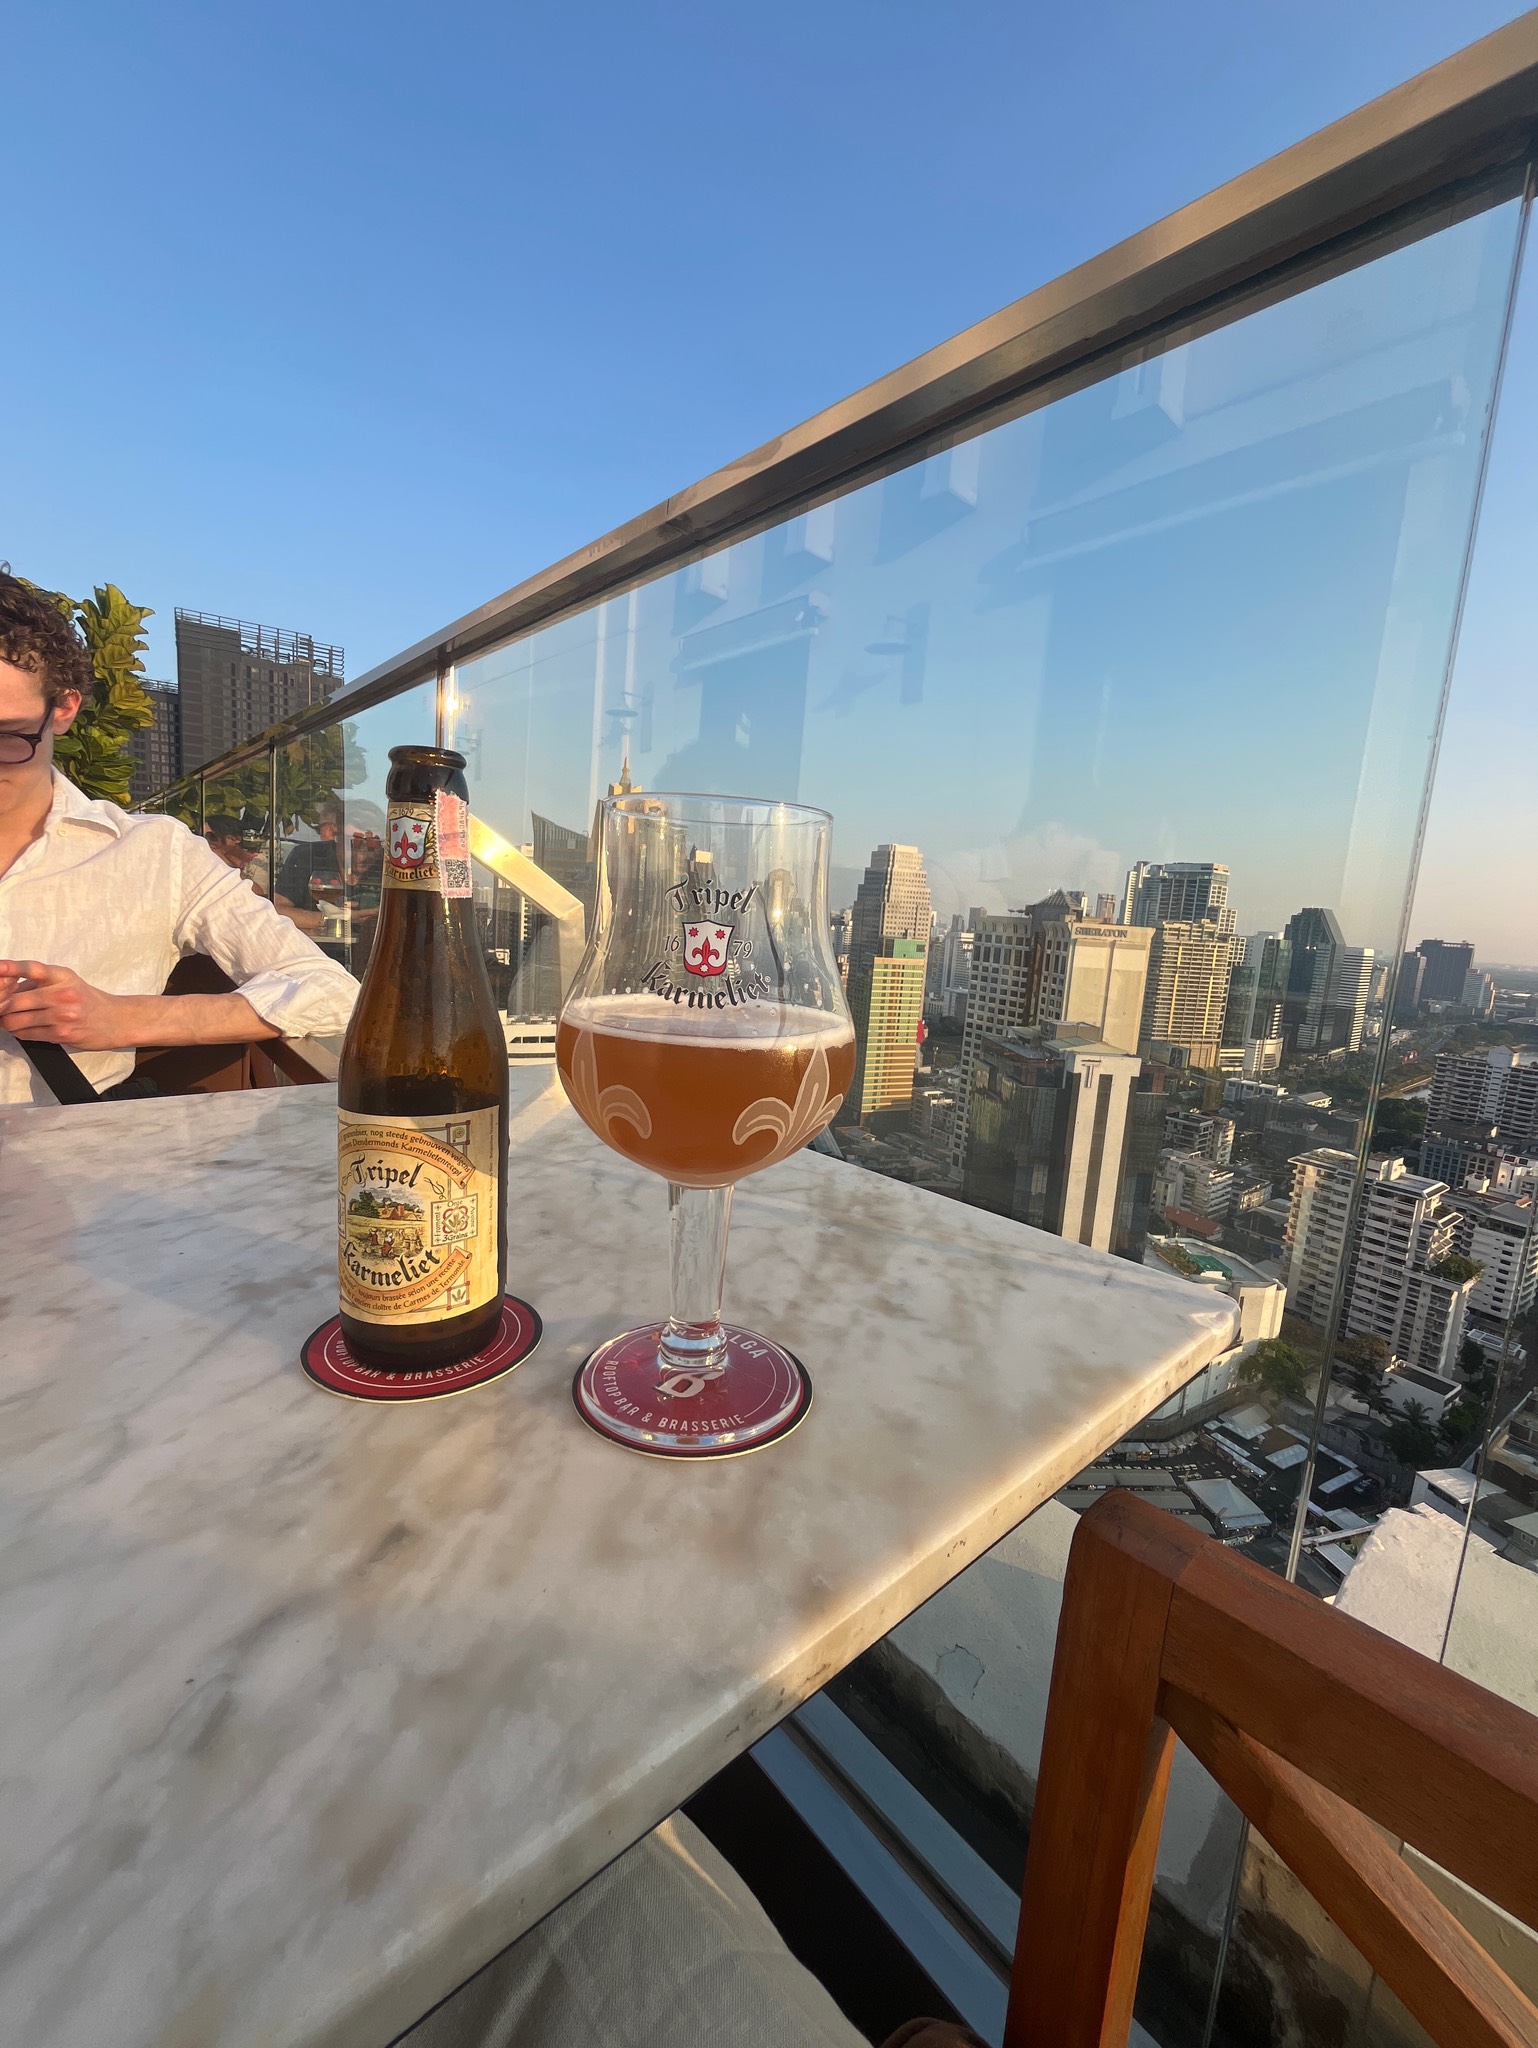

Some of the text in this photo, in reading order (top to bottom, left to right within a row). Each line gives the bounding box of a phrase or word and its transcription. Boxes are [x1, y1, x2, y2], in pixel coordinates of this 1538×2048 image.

[665, 873, 759, 914] Tripel
[664, 935, 753, 958] 16 79
[1075, 926, 1128, 938] SHERATON
[641, 959, 770, 1010] Karmeliet
[350, 1152, 425, 1189] Tripel
[352, 1138, 398, 1148] Dendermonds
[401, 1142, 463, 1177] Karmelietenrecept
[370, 1130, 384, 1138] nog
[385, 1130, 409, 1140] steeds
[410, 1135, 451, 1156] gebrouwen
[450, 1152, 471, 1173] volgens
[447, 1200, 463, 1208] Orge
[343, 1241, 440, 1287] Karmeliet
[358, 1289, 381, 1301] toujours
[407, 1285, 426, 1298] selon
[426, 1277, 439, 1288] une
[438, 1258, 456, 1278] recette
[403, 1294, 431, 1308] Carmes
[431, 1287, 440, 1295] de
[439, 1260, 466, 1288] Termonde
[386, 1372, 395, 1381] &
[403, 1356, 484, 1381] BRASSERIE
[602, 1360, 745, 1432] ROOFTOPBAR & BRASSERIE
